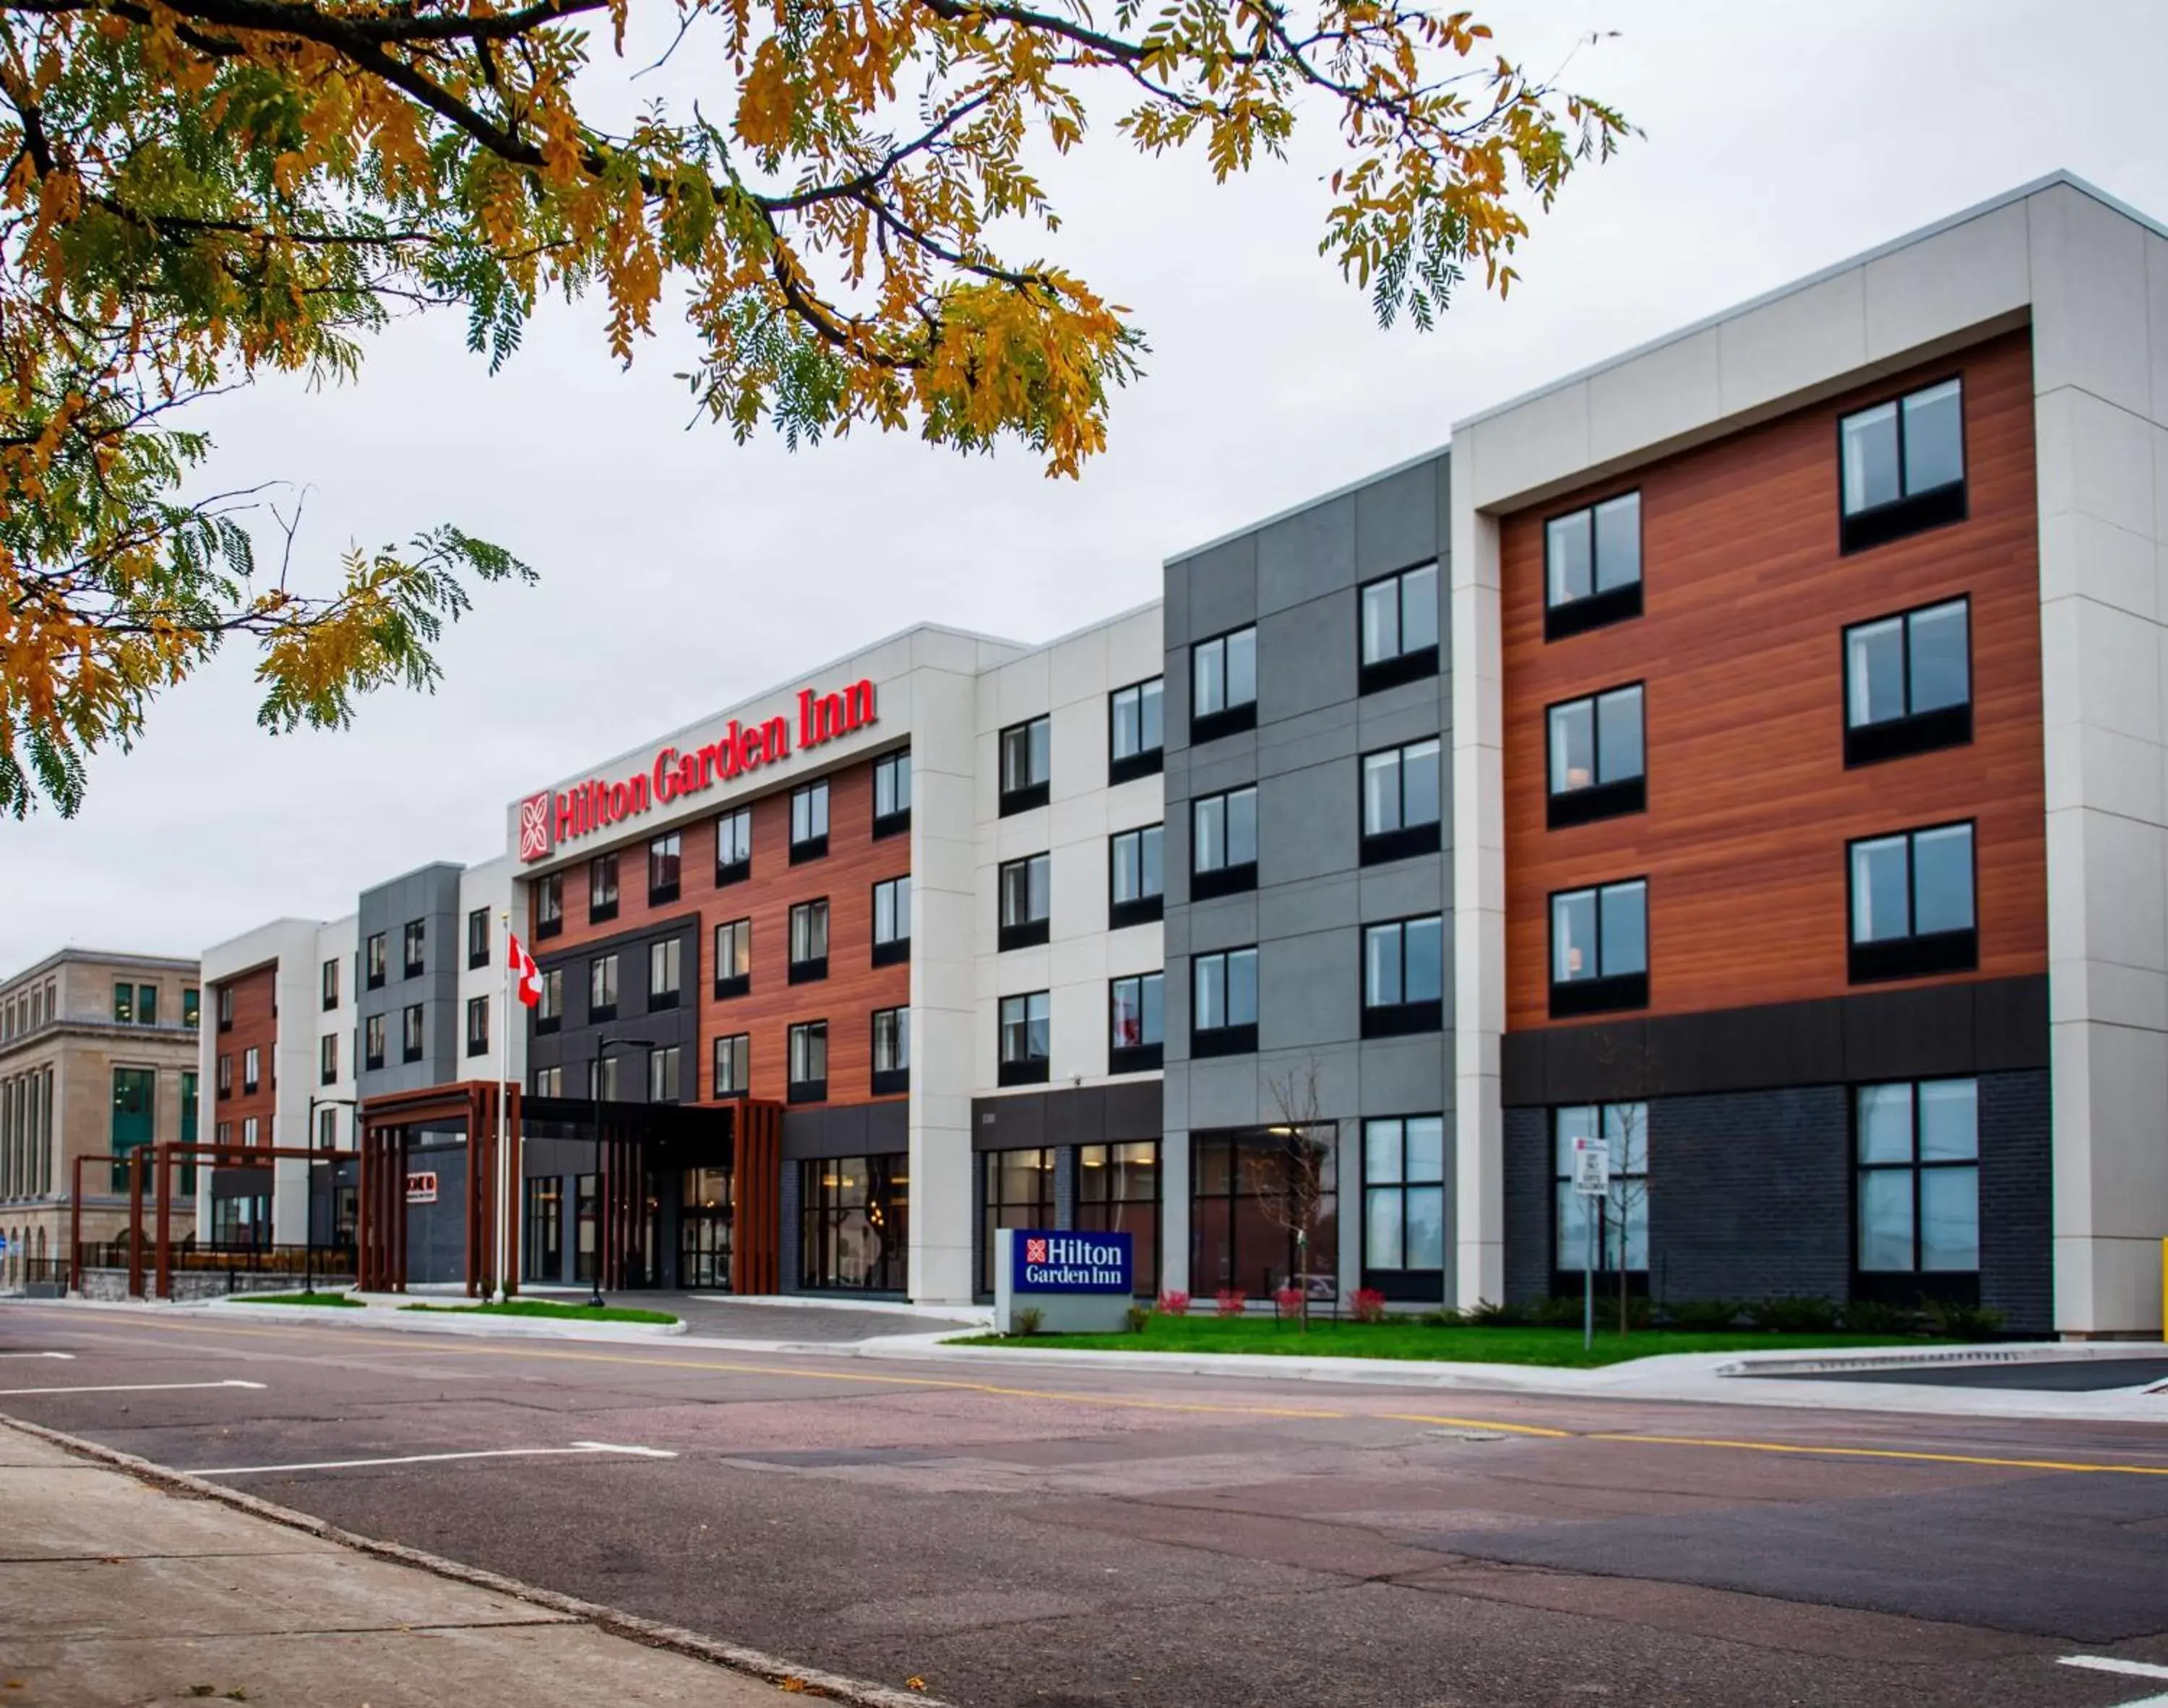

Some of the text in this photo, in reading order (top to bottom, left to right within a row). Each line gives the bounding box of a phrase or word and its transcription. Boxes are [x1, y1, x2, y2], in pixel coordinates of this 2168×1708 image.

[555, 679, 877, 842] Hilton Garden Inn
[1048, 1239, 1122, 1265] Hilton
[1026, 1265, 1122, 1284] Garden Inn
